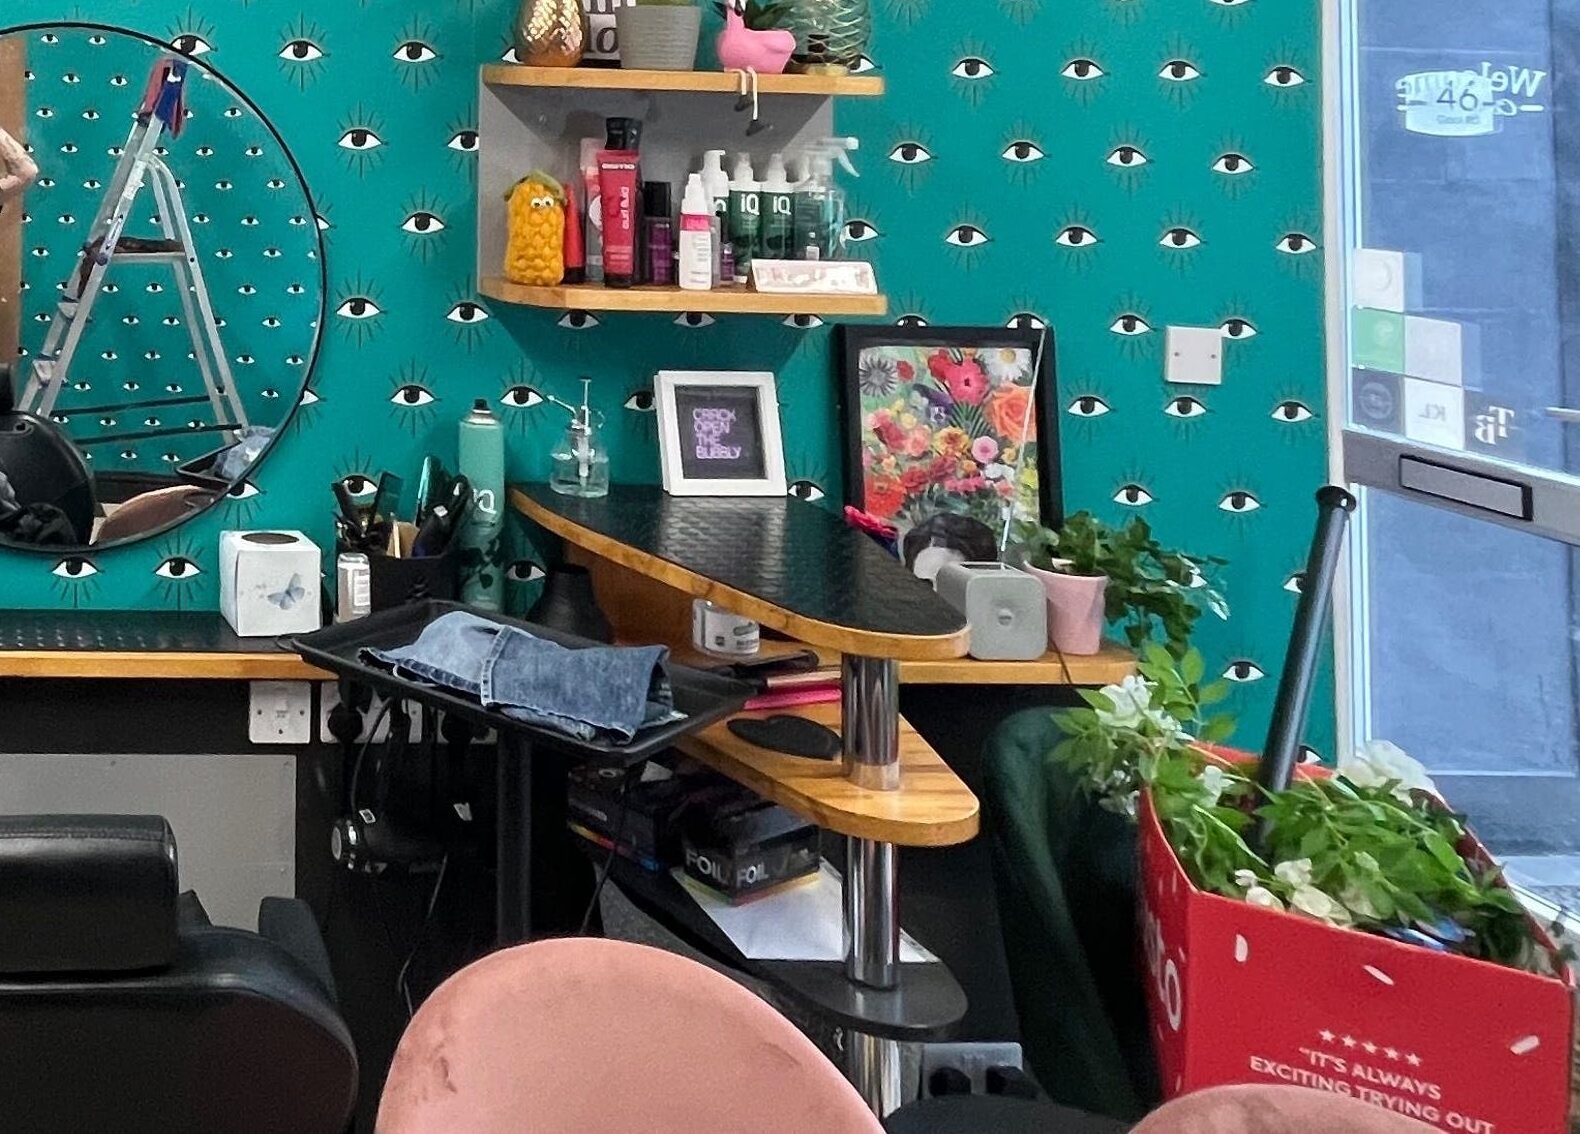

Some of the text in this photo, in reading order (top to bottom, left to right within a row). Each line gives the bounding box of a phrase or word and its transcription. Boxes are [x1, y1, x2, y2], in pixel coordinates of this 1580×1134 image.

[694, 421, 730, 434] OPEN
[696, 433, 721, 446] THE
[696, 446, 742, 459] BUBBLY
[685, 848, 729, 885] FOIL
[736, 861, 769, 888] FOIL
[1249, 1055, 1495, 1134] EXCITING TRYING OUT
[1351, 1063, 1442, 1101] ALWAYS
